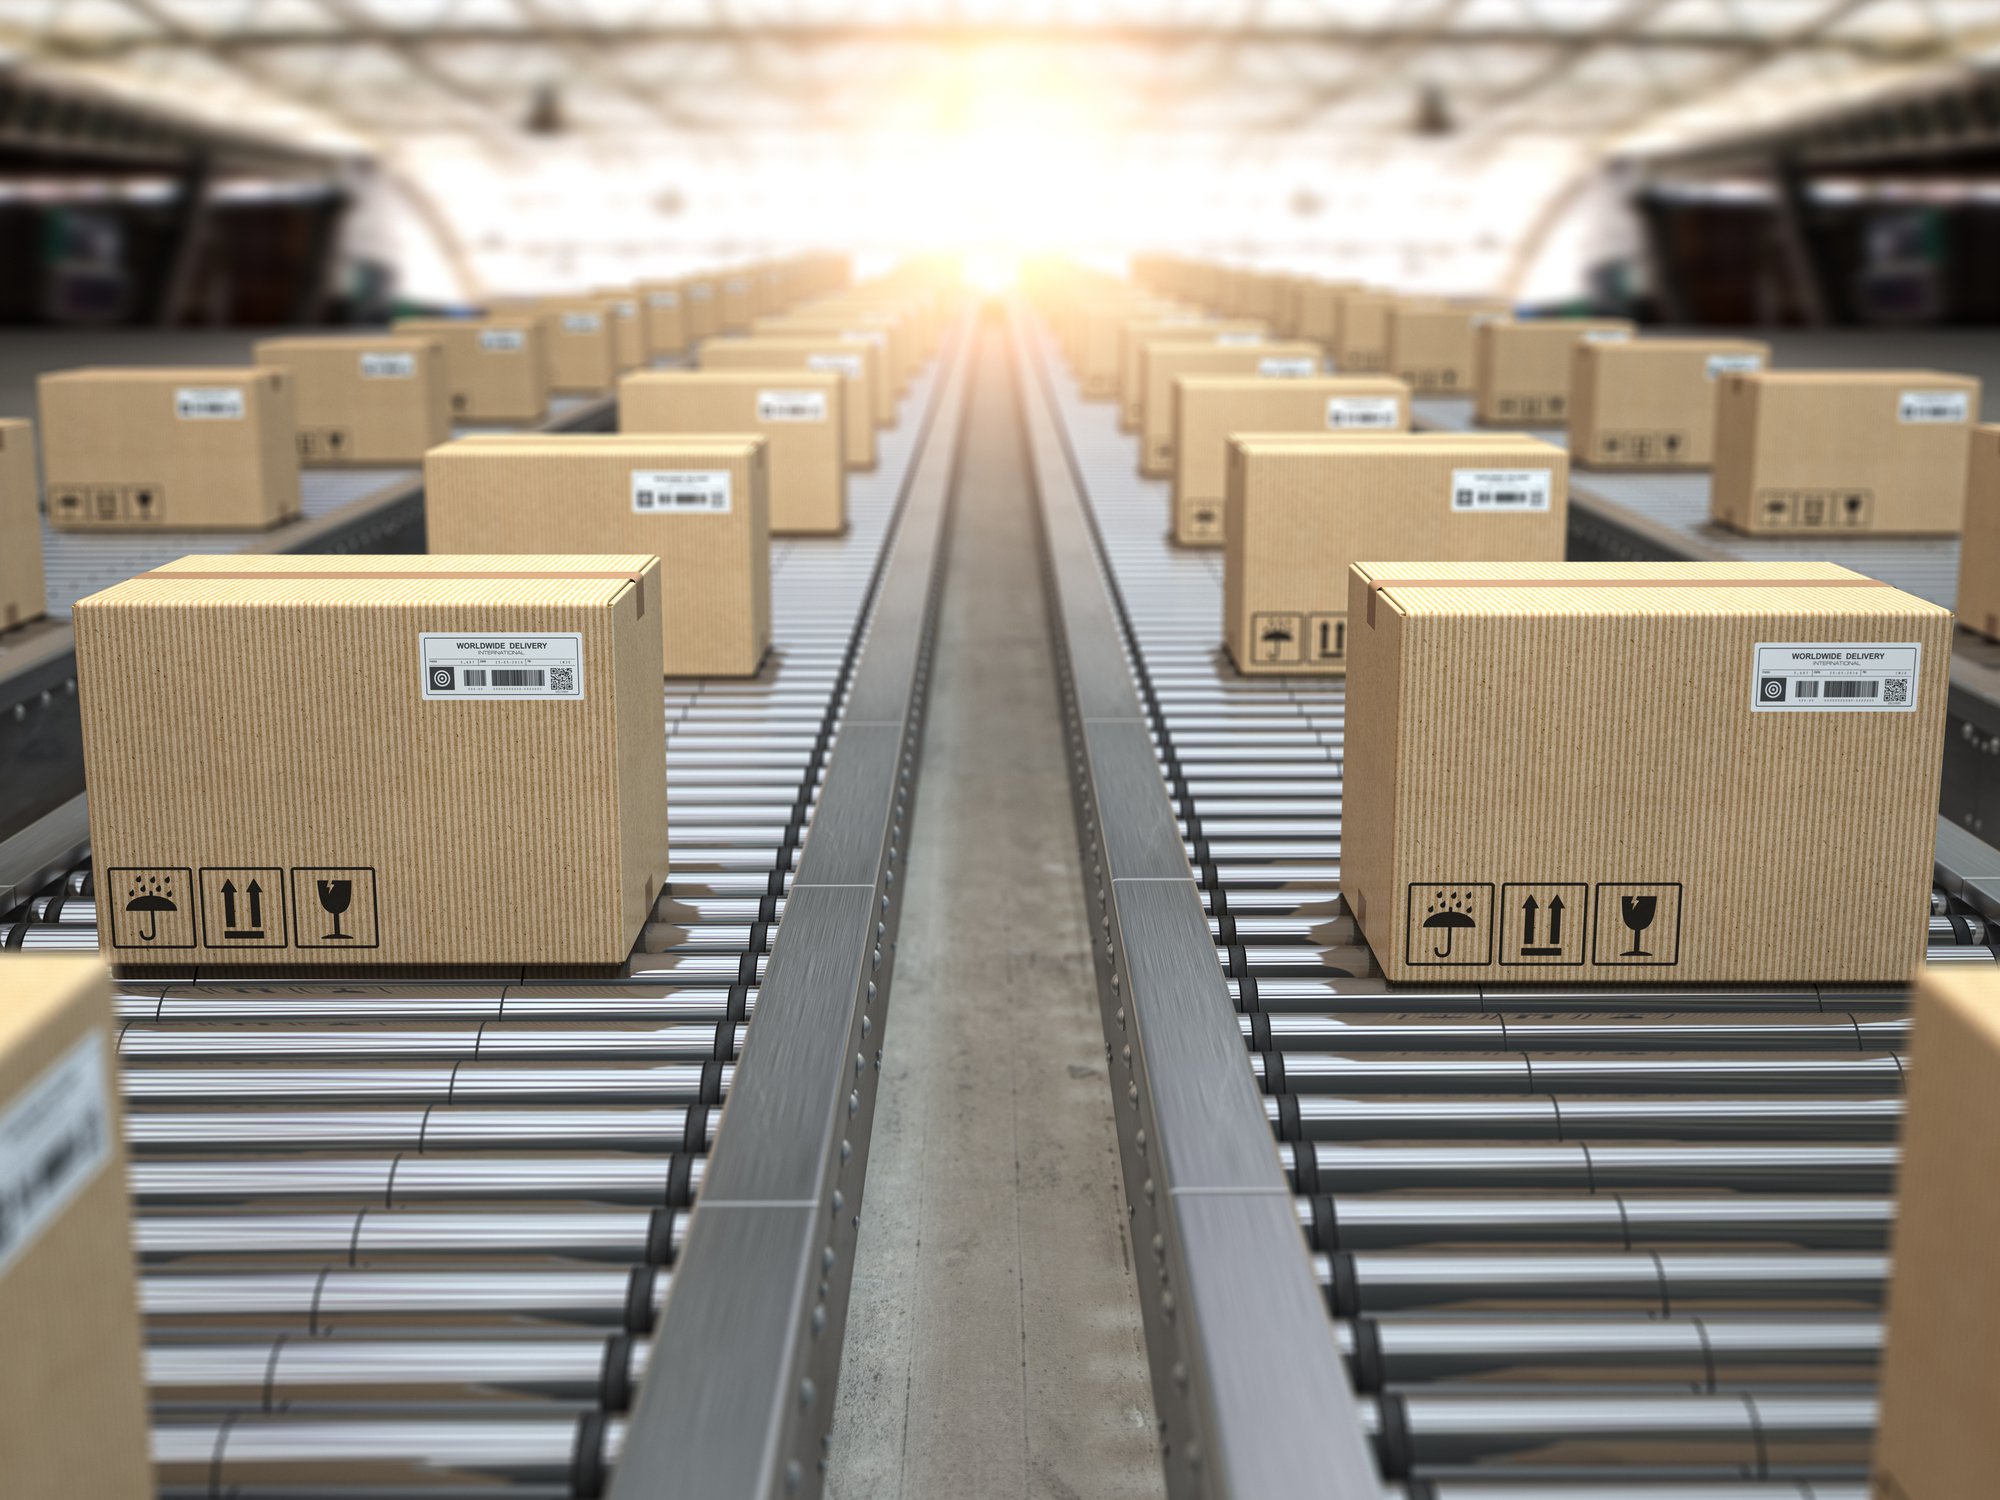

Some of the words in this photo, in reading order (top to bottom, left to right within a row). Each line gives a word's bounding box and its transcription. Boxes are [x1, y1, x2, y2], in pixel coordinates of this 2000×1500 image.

[456, 642, 506, 650] WORLDWIDE
[509, 642, 548, 650] DELIVERY
[1791, 652, 1842, 660] WORLDWIDE
[1845, 652, 1885, 660] DELIVERY
